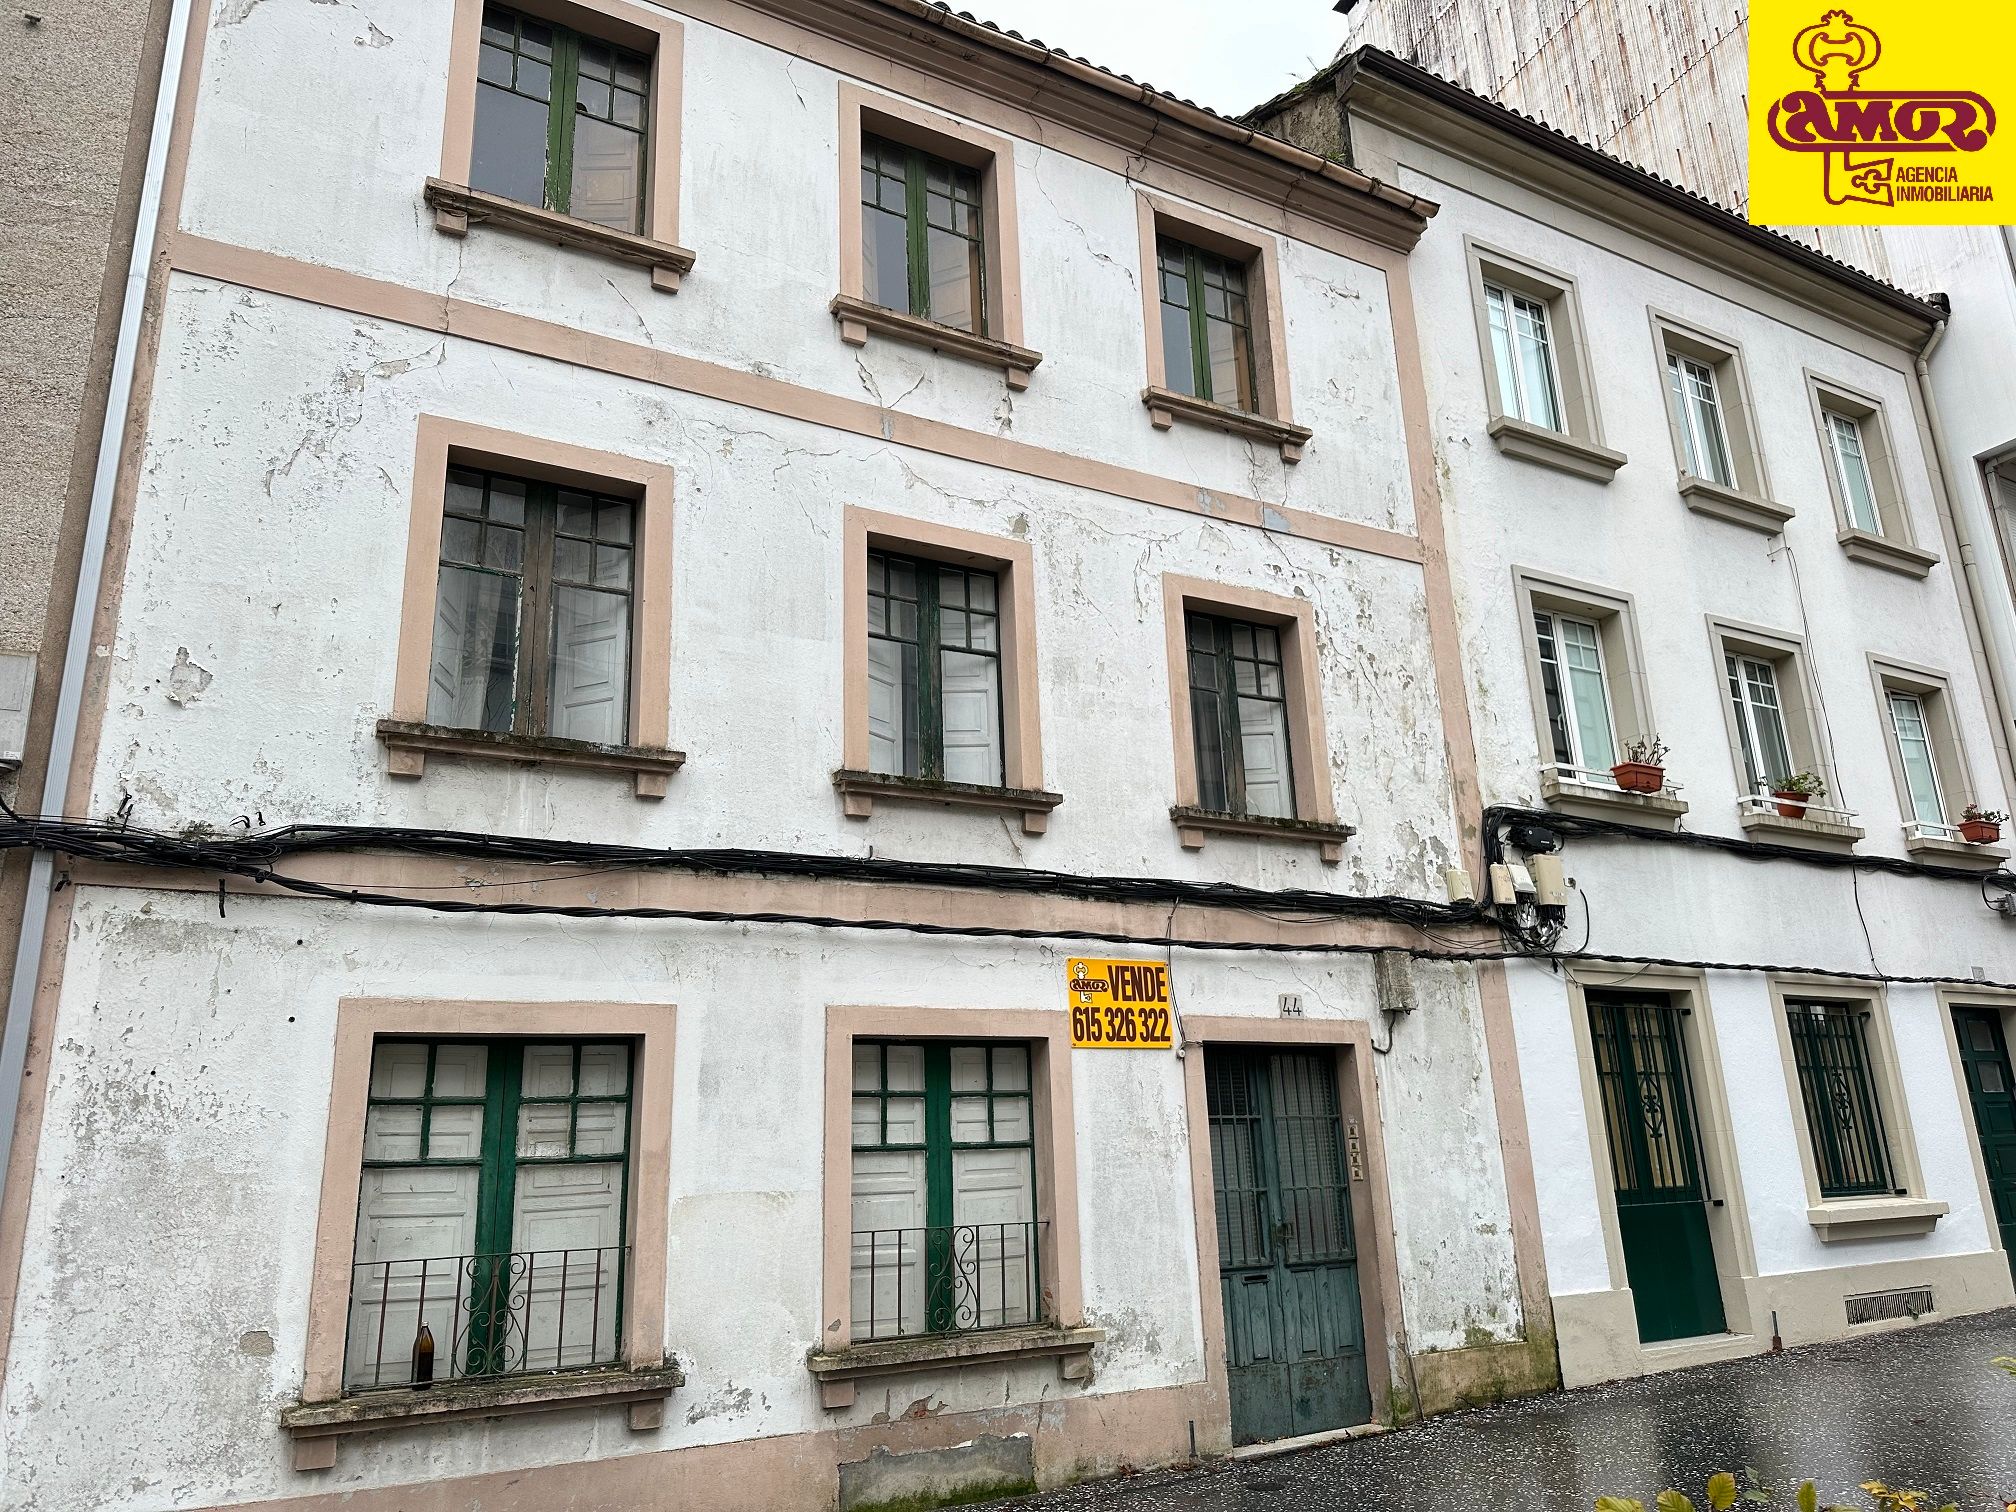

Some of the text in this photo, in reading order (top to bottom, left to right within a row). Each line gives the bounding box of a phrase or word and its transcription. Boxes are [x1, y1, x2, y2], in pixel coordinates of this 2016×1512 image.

[1072, 979, 1108, 992] AMOR
[1107, 965, 1168, 1002] VENDE
[1283, 997, 1302, 1016] 44
[1072, 1006, 1171, 1042] 615 326 322
